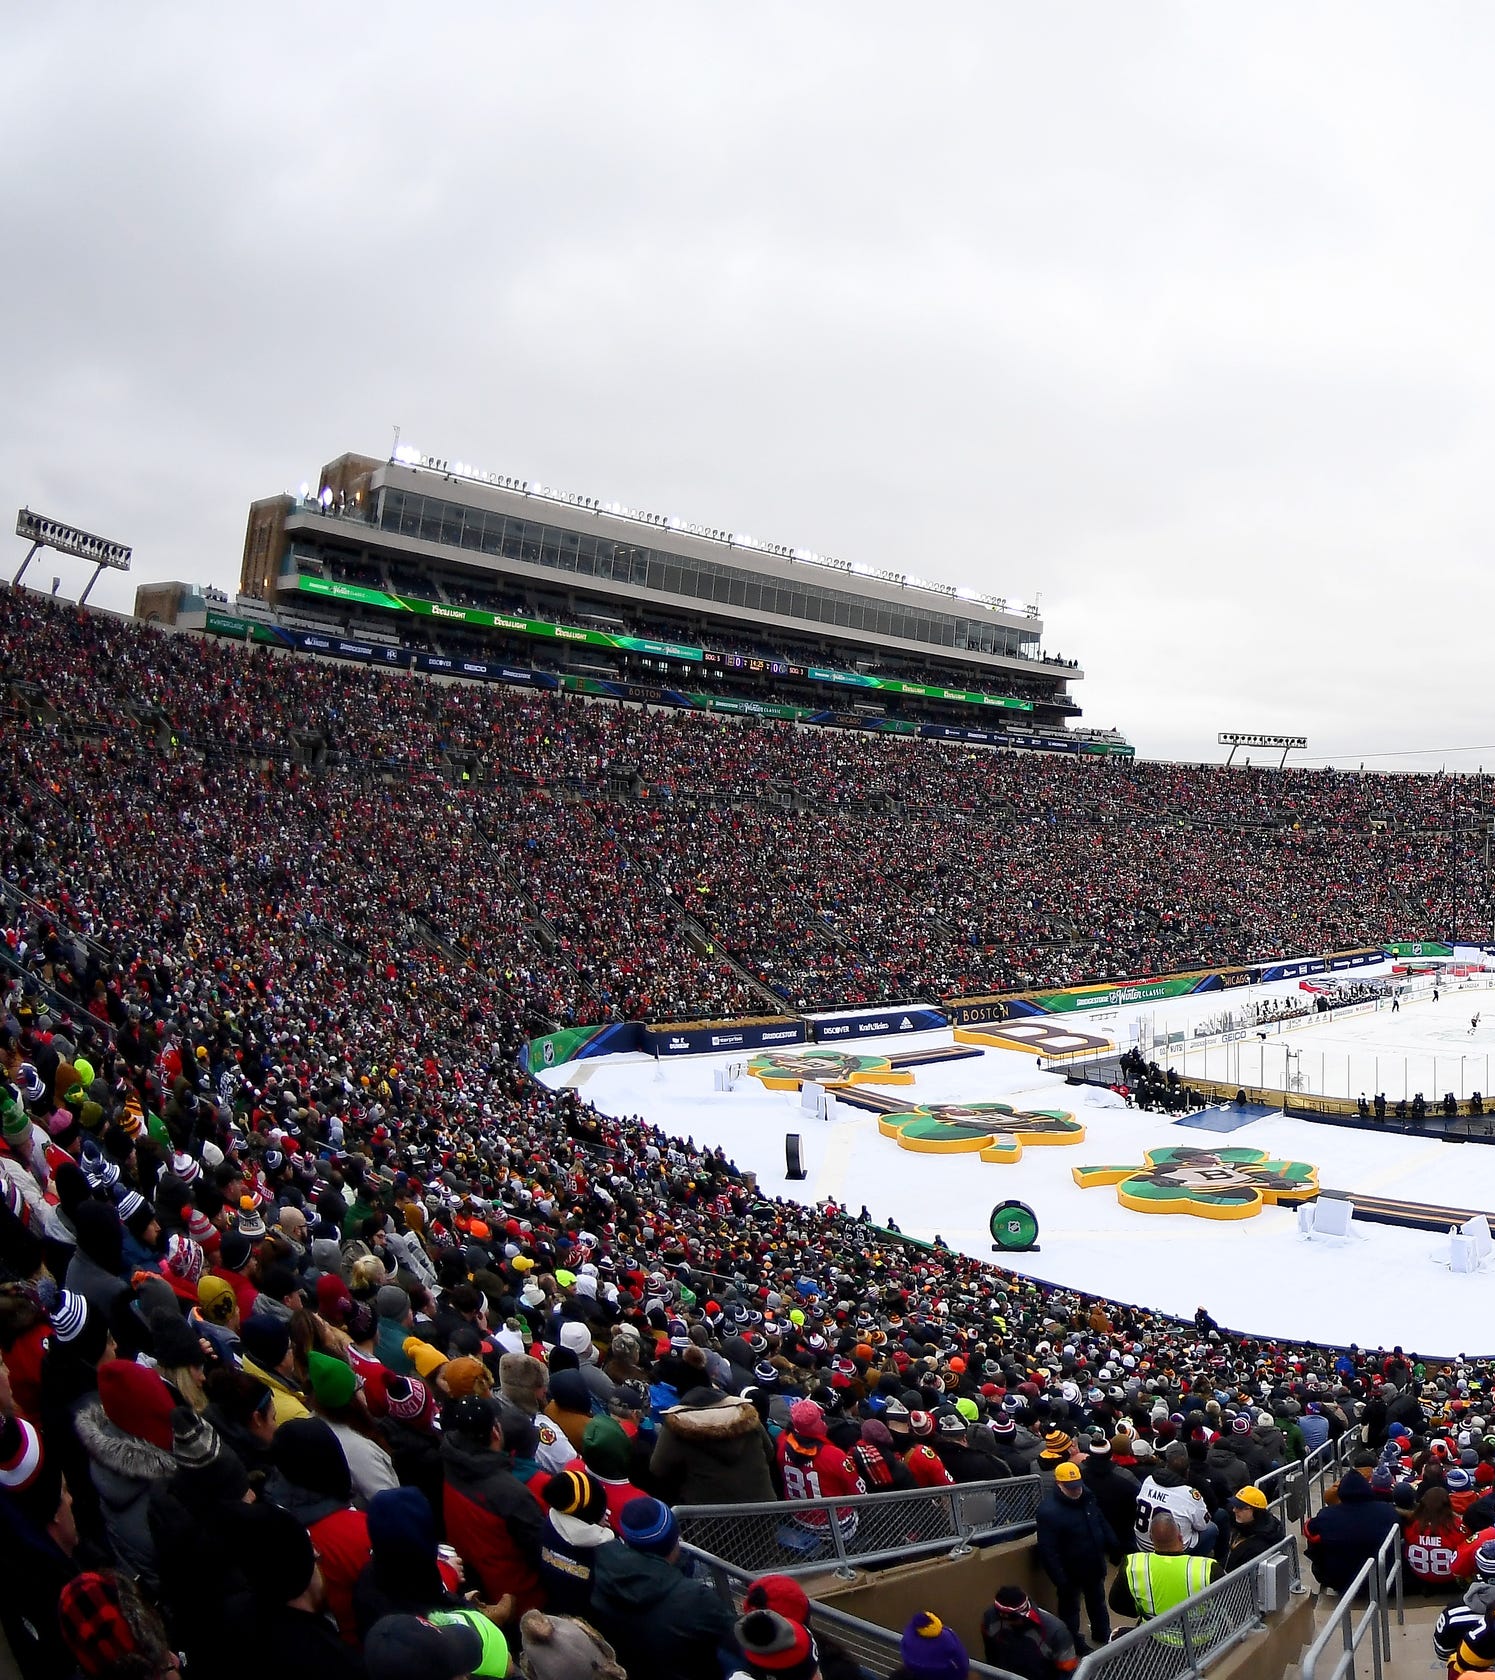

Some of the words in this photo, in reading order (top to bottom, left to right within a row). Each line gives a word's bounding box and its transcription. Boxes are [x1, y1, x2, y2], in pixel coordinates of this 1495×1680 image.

[450, 611, 466, 619] LIGHT
[512, 622, 527, 630] LIGHT
[572, 632, 587, 640] LIGHT
[736, 658, 740, 666] 0
[464, 664, 486, 672] GEICO
[774, 664, 778, 672] 0
[628, 687, 661, 700] BOSTON
[1222, 975, 1250, 988] HICAGO
[1117, 987, 1142, 1005] Winter
[1142, 988, 1166, 998] CLASSIC
[762, 1030, 797, 1041] BRIDGESTONE
[824, 1026, 850, 1034] DISCOVER
[1222, 1030, 1246, 1043] GEICO
[784, 1465, 822, 1500] 81
[1148, 1488, 1169, 1504] KANE
[1136, 1498, 1173, 1534] 8
[1419, 1536, 1442, 1546] KANE
[1408, 1544, 1452, 1576] 88
